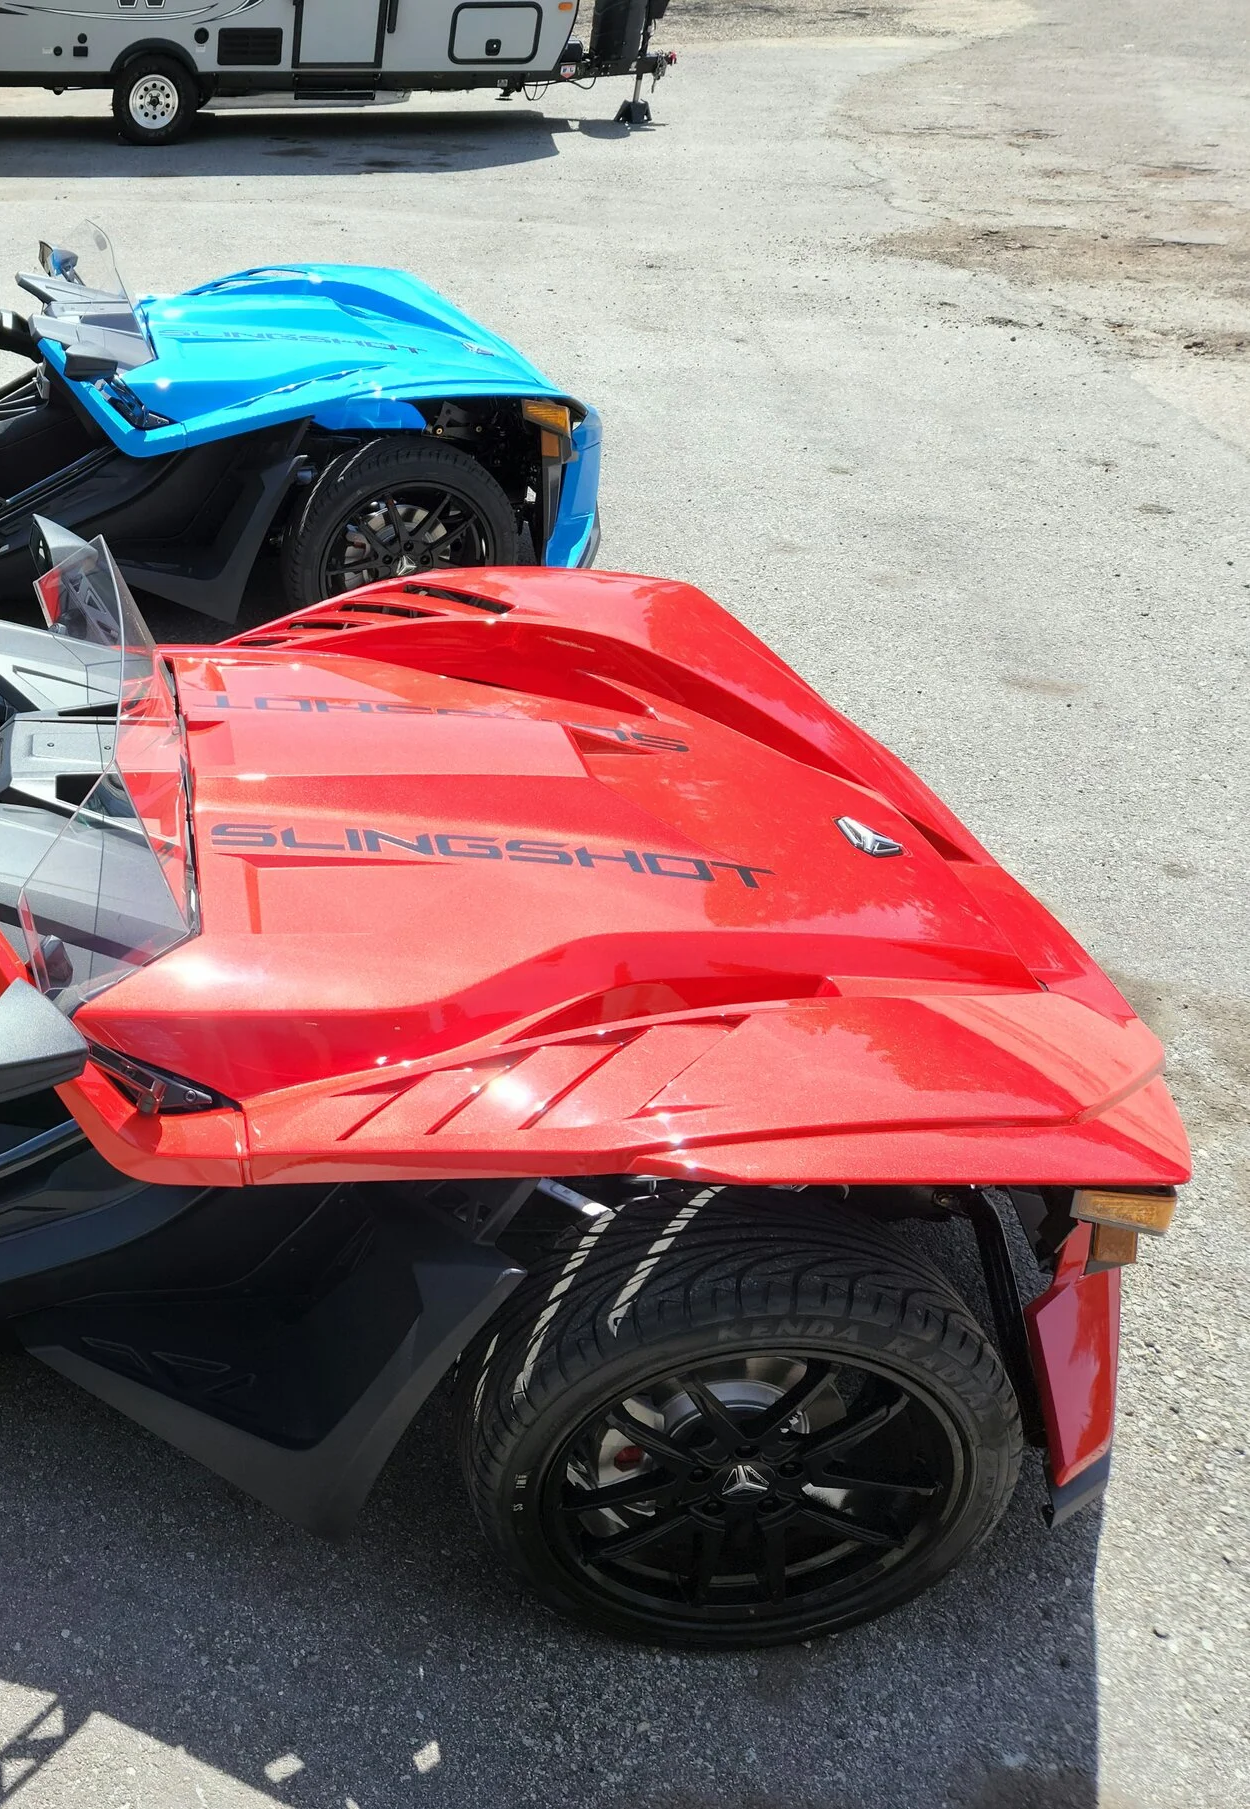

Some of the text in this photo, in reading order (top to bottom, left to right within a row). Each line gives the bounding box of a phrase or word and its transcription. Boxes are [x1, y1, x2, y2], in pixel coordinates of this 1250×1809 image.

[158, 329, 428, 354] SLINGSHOT
[211, 823, 776, 889] SLINGSHOT
[717, 1318, 860, 1342] KENDA
